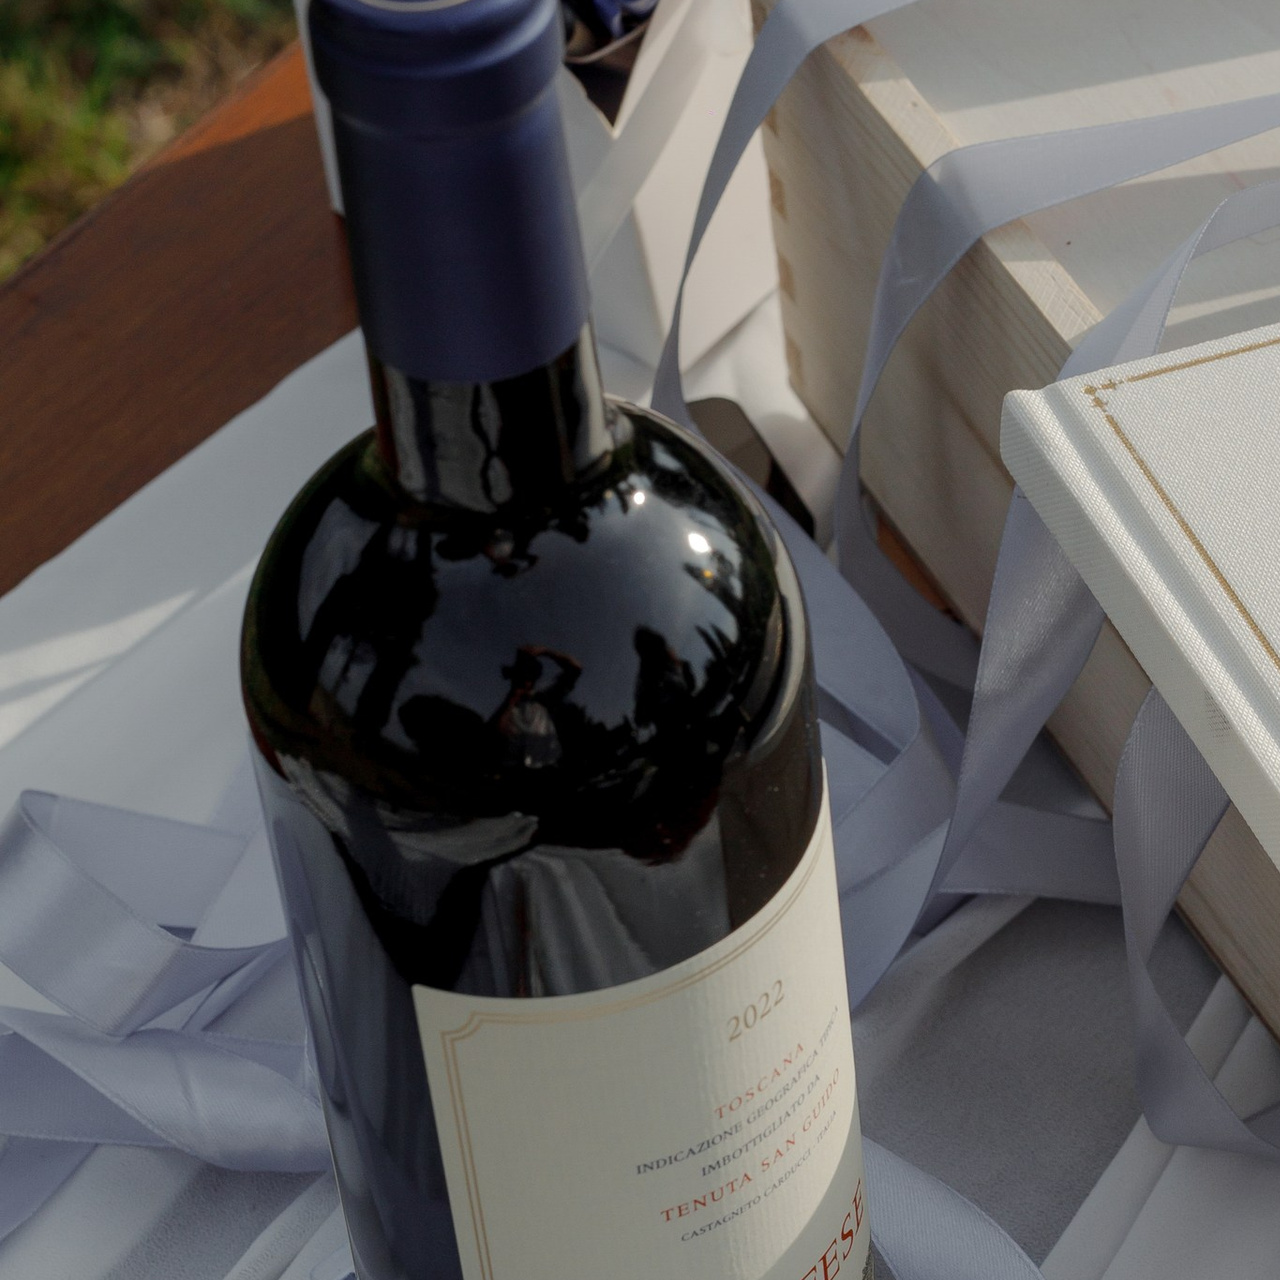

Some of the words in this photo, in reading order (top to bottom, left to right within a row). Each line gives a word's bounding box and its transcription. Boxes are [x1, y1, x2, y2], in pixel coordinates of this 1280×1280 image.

[728, 978, 786, 1043] 2022
[636, 1122, 744, 1175] INDICAZIONE
[746, 1048, 820, 1125] GEOGRAFICA
[701, 1092, 805, 1177] IMBOTTIGLIATO
[806, 1073, 821, 1097] DA
[714, 1042, 804, 1120] TOSCANA
[660, 1171, 754, 1223] TENUTA
[760, 1132, 797, 1174] SAN
[802, 1067, 840, 1133] GUIDO
[680, 1194, 762, 1243] CASTAGNETO
[763, 1151, 812, 1198] CARDUCCI
